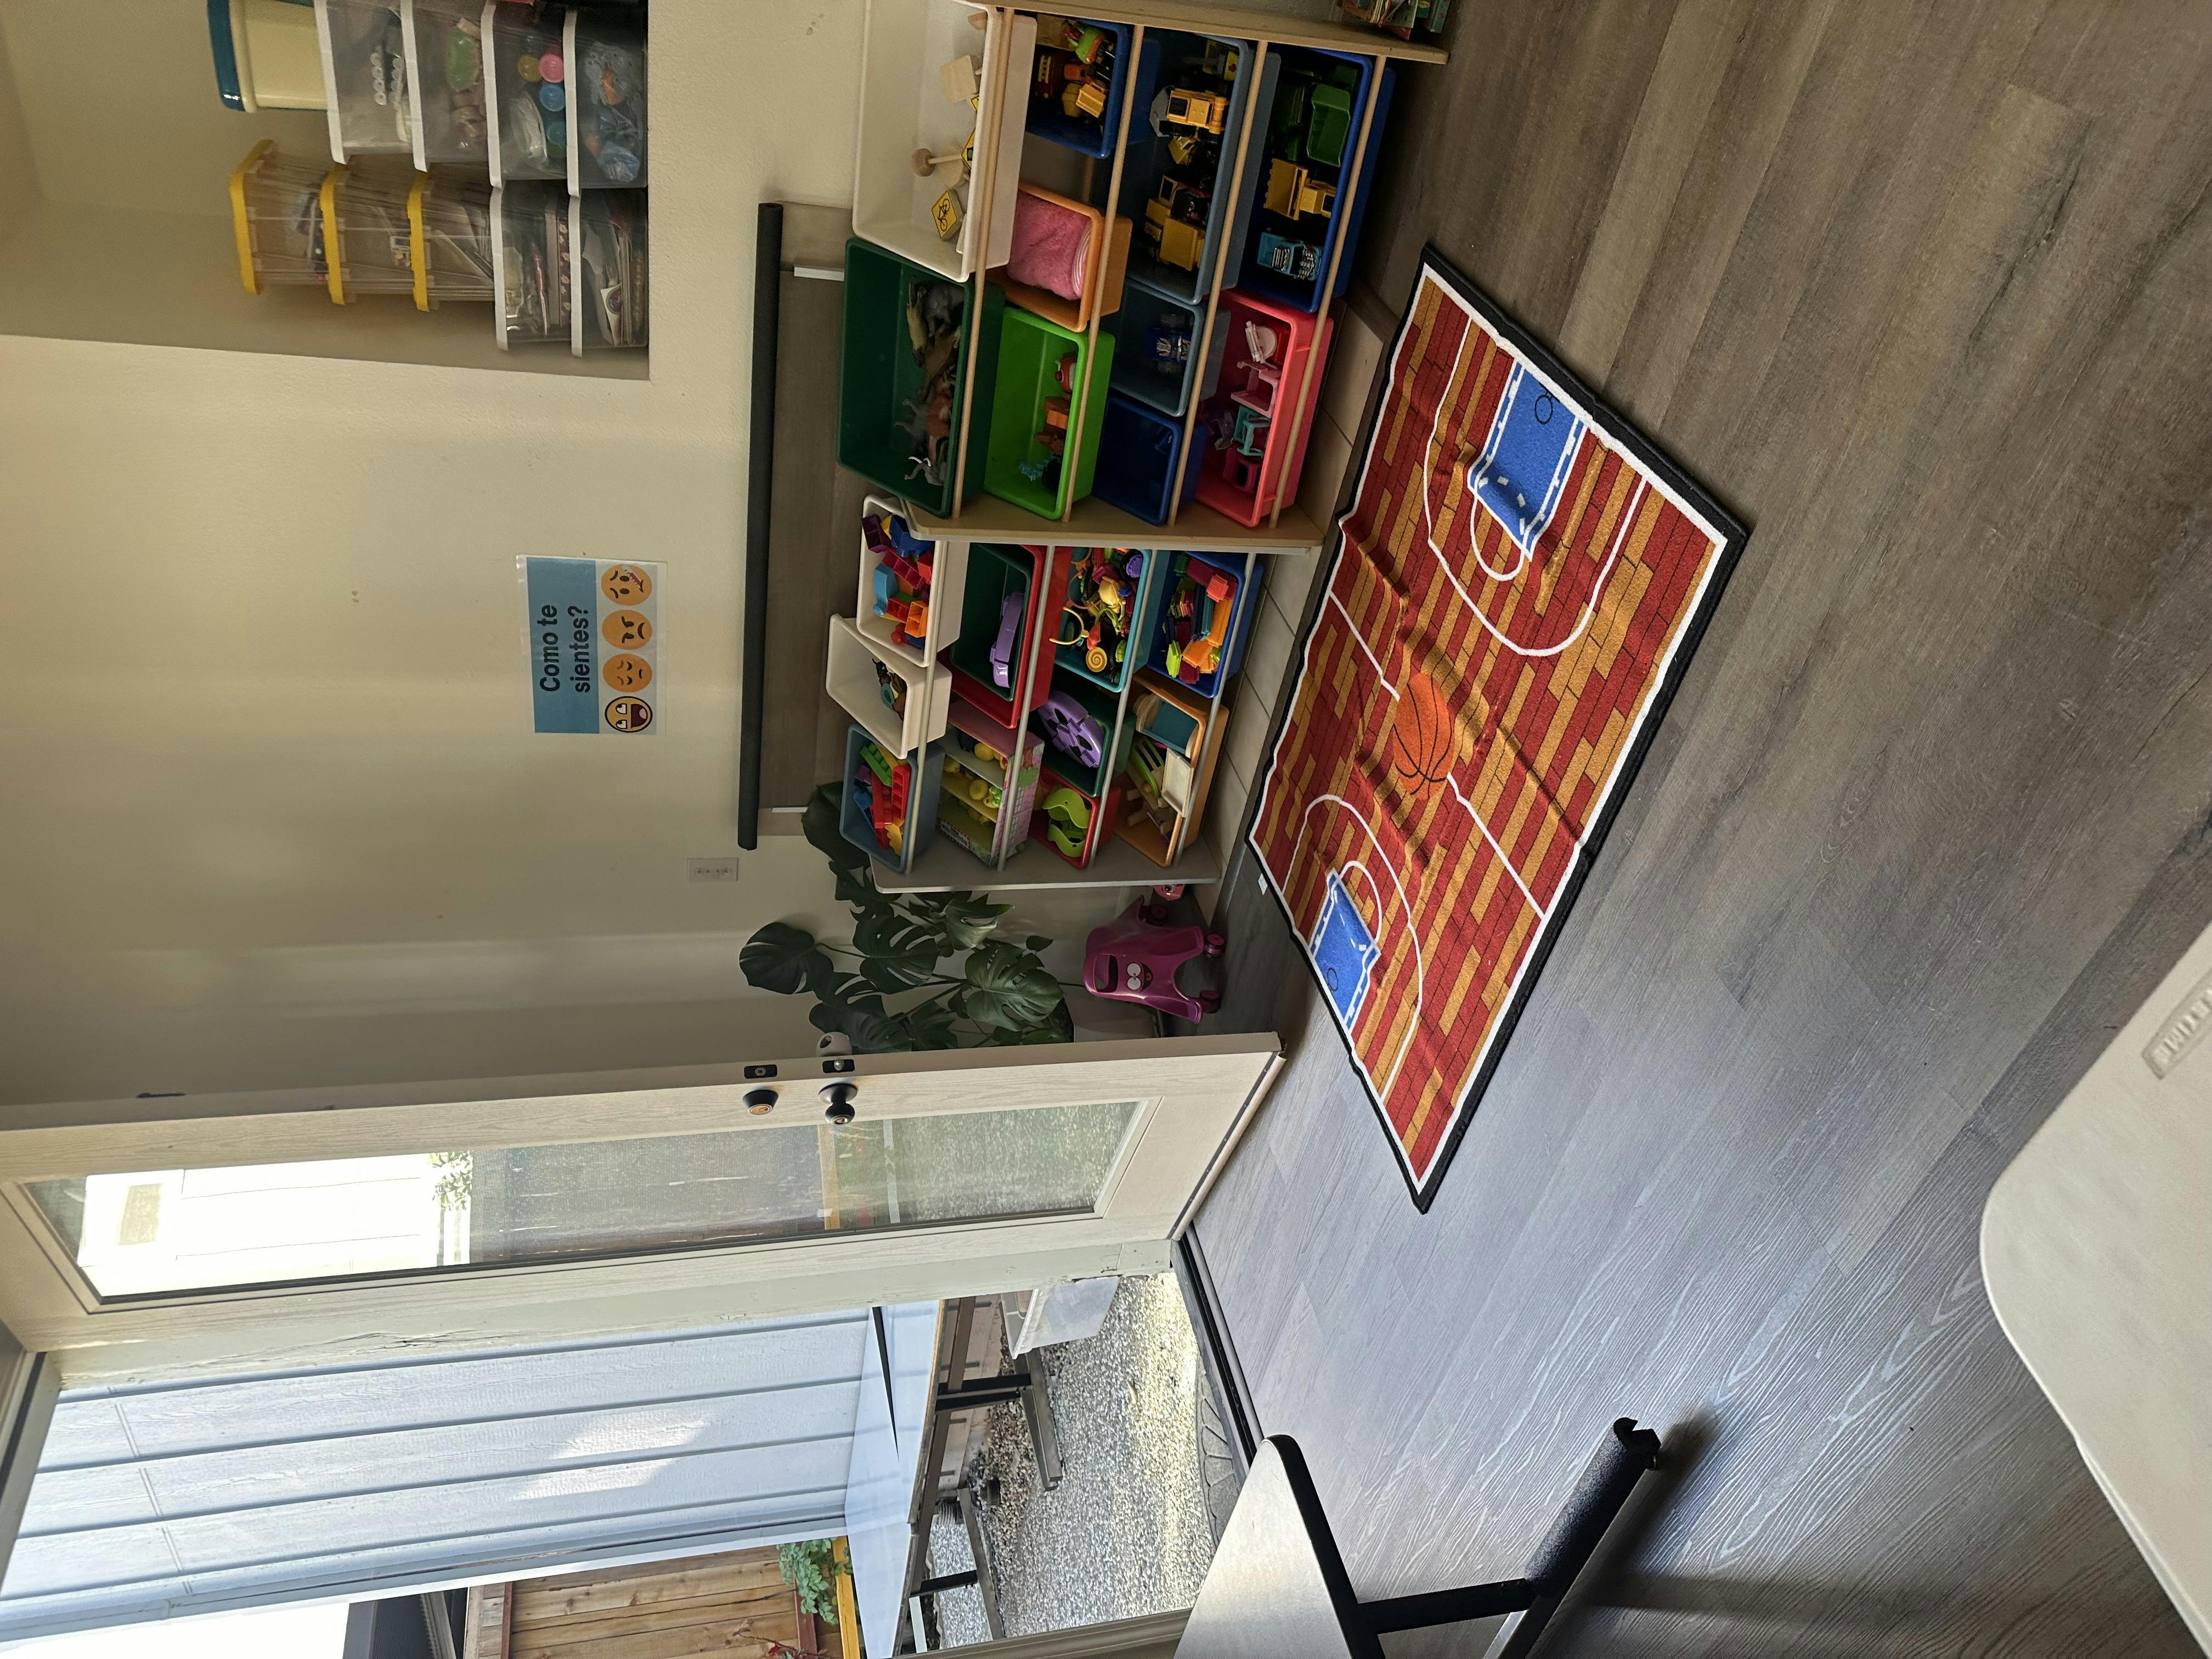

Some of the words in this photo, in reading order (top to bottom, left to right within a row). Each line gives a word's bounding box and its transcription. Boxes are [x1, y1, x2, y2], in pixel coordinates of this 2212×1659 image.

[537, 605, 558, 627] te
[539, 631, 561, 692] Como
[567, 606, 590, 693] sientes?
